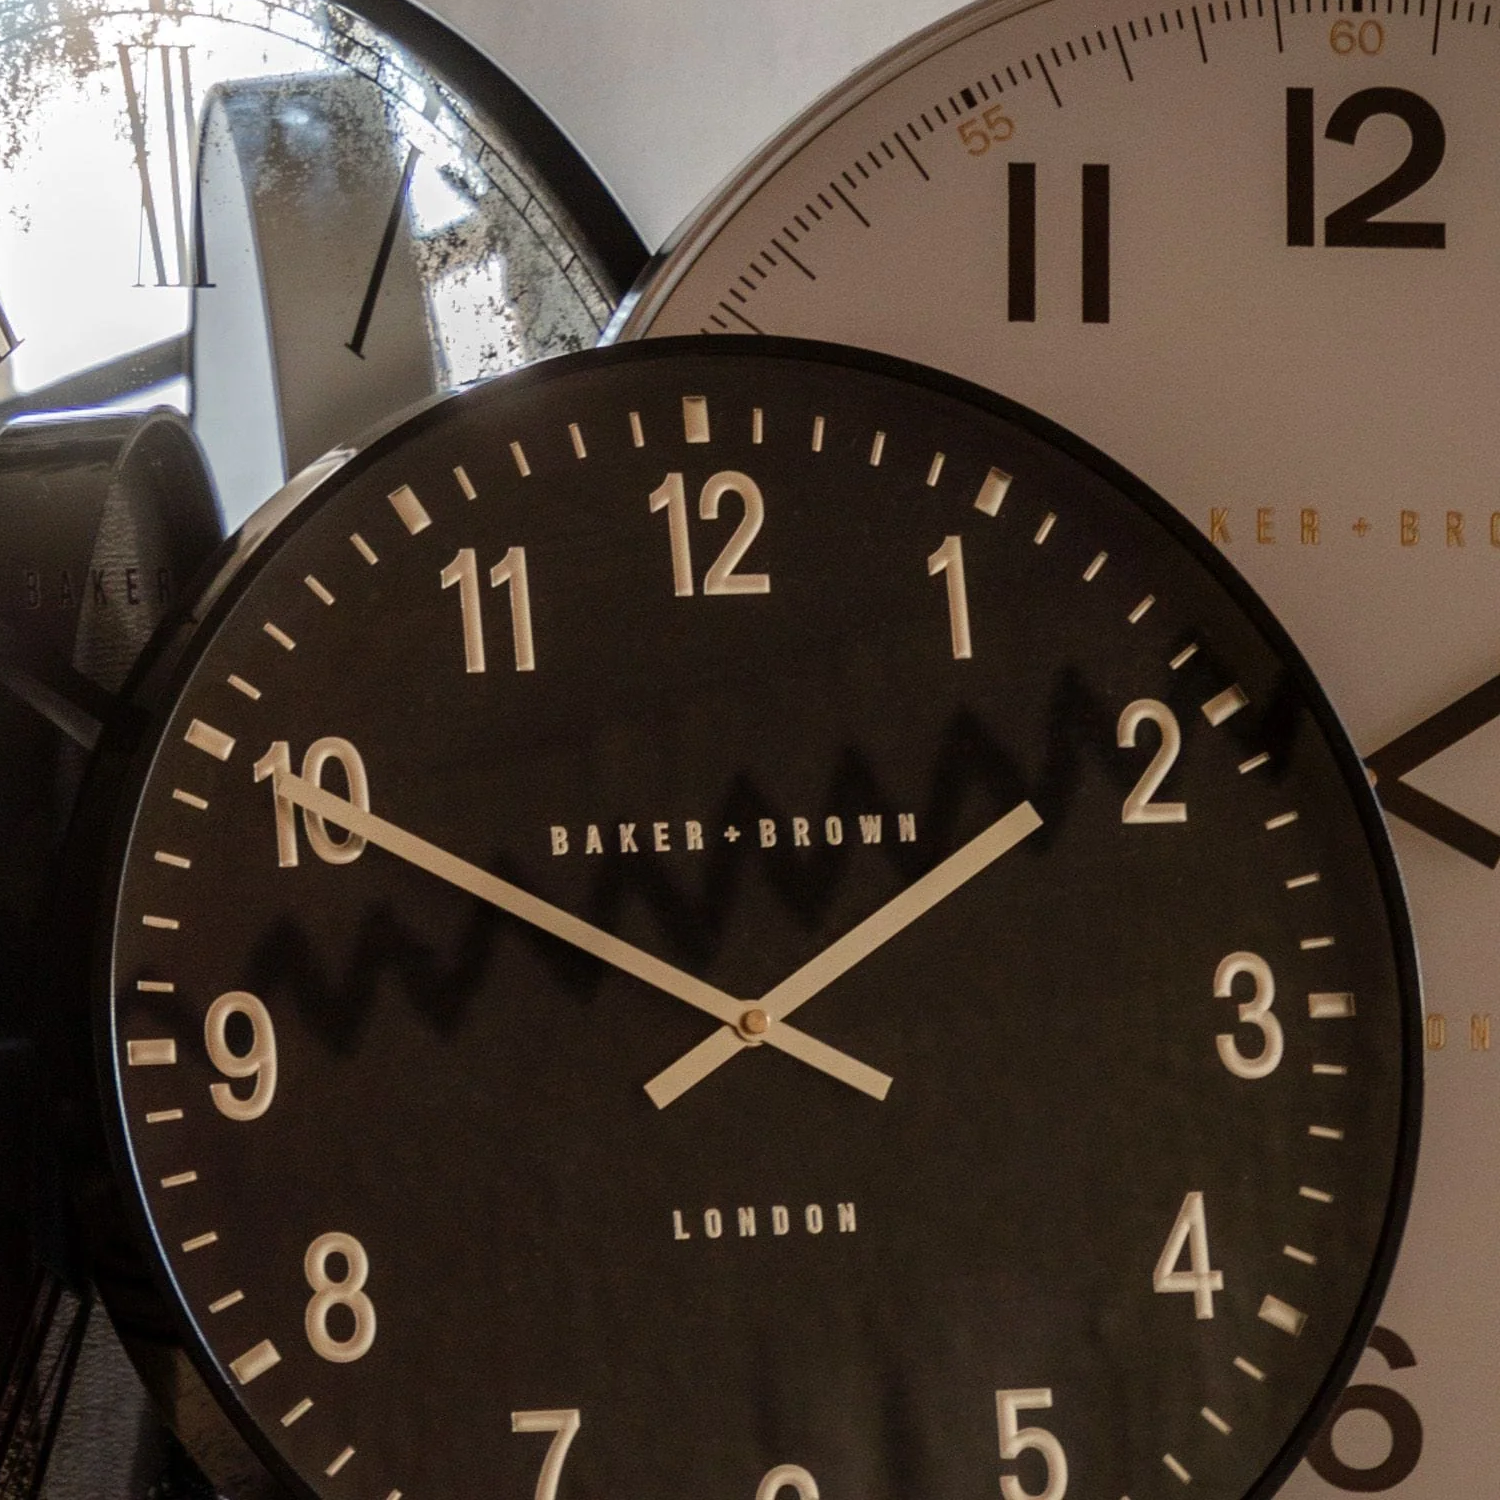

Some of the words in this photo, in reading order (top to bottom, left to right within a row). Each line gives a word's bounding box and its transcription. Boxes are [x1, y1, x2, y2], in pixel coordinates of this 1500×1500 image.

[1329, 19, 1384, 57] 60
[957, 105, 1015, 157] 55
[1286, 87, 1447, 249] 12
[1008, 162, 1110, 323] 11
[649, 470, 770, 597] 12
[440, 545, 534, 672] 11
[927, 535, 971, 660] 1
[253, 736, 370, 868] 10
[1116, 699, 1188, 825] 2
[204, 991, 277, 1121] 9
[1213, 951, 1284, 1079] 3
[673, 1202, 857, 1241] LONDON
[1153, 1191, 1224, 1320] 4
[304, 1232, 376, 1363] 8
[511, 1409, 581, 1500] 7
[995, 1388, 1068, 1500] 5
[1303, 1325, 1423, 1493] 6
